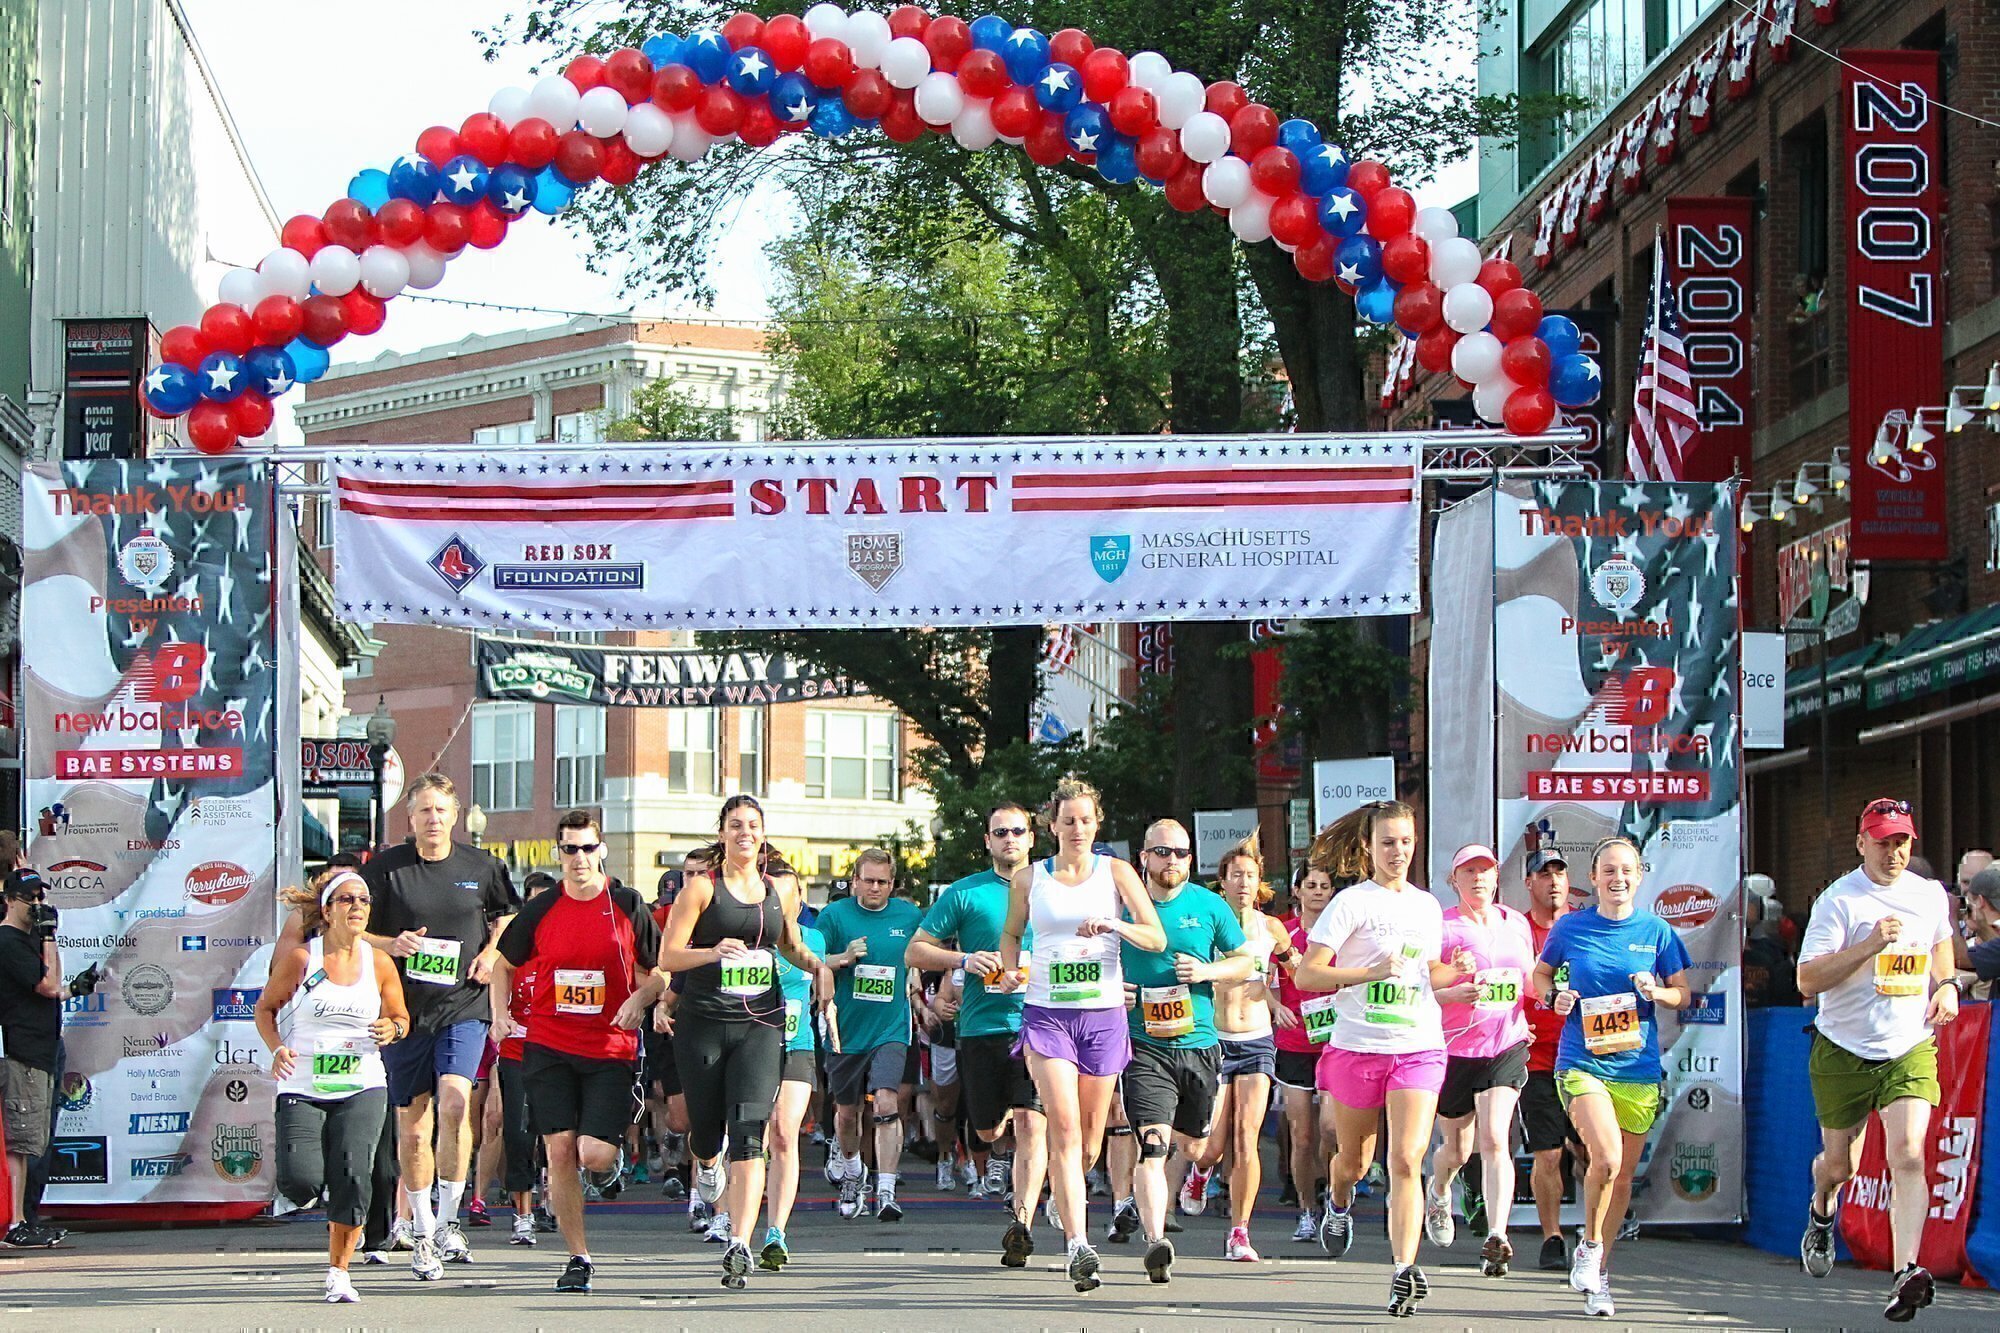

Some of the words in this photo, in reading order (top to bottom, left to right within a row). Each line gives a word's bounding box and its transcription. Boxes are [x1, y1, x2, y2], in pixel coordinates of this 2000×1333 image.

[1852, 80, 1934, 328] 2007
[68, 324, 99, 340] RED
[101, 323, 131, 339] SOX
[1677, 223, 1744, 433] 2004
[85, 406, 113, 429] open
[85, 432, 112, 455] year
[48, 486, 156, 516] Thank
[160, 484, 246, 512] You!
[749, 476, 998, 515] START
[1519, 508, 1627, 537] Thank
[1633, 509, 1714, 537] You!
[852, 535, 897, 550] HOME
[1141, 529, 1311, 549] MASSACHUSETTS
[525, 544, 564, 561] RED
[573, 544, 612, 561] SOX
[852, 550, 897, 563] BASE
[1093, 549, 1127, 562] MGH
[1141, 552, 1238, 569] GENERAL
[1242, 550, 1339, 567] HOSPITAL
[502, 569, 636, 584] FOUNDATION
[855, 564, 894, 572] PROGRAM
[1101, 563, 1119, 571] 1811
[90, 595, 205, 614] Presented
[131, 614, 158, 636] by
[1561, 617, 1674, 635] Presented
[1602, 637, 1629, 659] by
[603, 650, 774, 685] FENWAY
[496, 667, 529, 682] 100
[530, 668, 586, 691] YEARS
[603, 685, 716, 705] YAWKEY
[724, 683, 783, 704] WAY
[55, 711, 114, 733] new
[120, 706, 244, 733] balance
[1527, 733, 1584, 754] new
[1590, 731, 1709, 754] balance
[66, 756, 112, 774] BAE
[121, 754, 233, 772] SYSTEMS
[321, 742, 374, 769] SOX
[328, 771, 370, 780] STORE
[1322, 785, 1352, 799] 6:00
[1357, 784, 1387, 798] Pace
[1538, 777, 1583, 794] BAE
[1592, 777, 1701, 795] SYSTEMS
[203, 811, 253, 819] ASSISTANCE
[68, 827, 119, 835] FOUNDATION
[1202, 829, 1226, 841] 7:00
[127, 839, 181, 850] EDWARDS
[1672, 842, 1694, 850] FUND
[50, 876, 105, 890] MCCA
[183, 876, 217, 900] Jerry
[216, 871, 257, 889] Remy's
[135, 906, 187, 919] randstad
[1655, 899, 1685, 918] Jerry
[1685, 895, 1722, 913] Remy's
[57, 934, 100, 949] Boston
[102, 933, 138, 949] Globe
[211, 938, 262, 948] COVIDIEN
[409, 951, 455, 975] 1234
[1052, 962, 1101, 983] 1388
[1690, 960, 1728, 970] OVIDIEN
[1891, 954, 1915, 975] 40
[725, 966, 771, 986] 1182
[563, 985, 596, 1005] 451
[856, 977, 894, 996] 1258
[1371, 982, 1419, 1007] 1047
[215, 1004, 257, 1015] PICERN
[1151, 1000, 1185, 1021] 408
[1306, 1008, 1337, 1030] 124
[1681, 1007, 1724, 1018] PICERNE
[1593, 1011, 1631, 1035] 443
[123, 1035, 157, 1047] Neuro
[123, 1046, 183, 1057] Restorative
[214, 1040, 259, 1065] dcr
[1678, 1047, 1720, 1073] dcr
[127, 1069, 145, 1079] Holly
[147, 1068, 181, 1078] McGrath
[150, 1080, 157, 1089] &
[130, 1093, 153, 1102] David
[154, 1092, 177, 1102] Bruce
[137, 1114, 181, 1133] NESN
[216, 1122, 257, 1138] Poland
[211, 1135, 263, 1162] Spring
[1675, 1142, 1715, 1157] Poland
[1670, 1156, 1720, 1179] Spring
